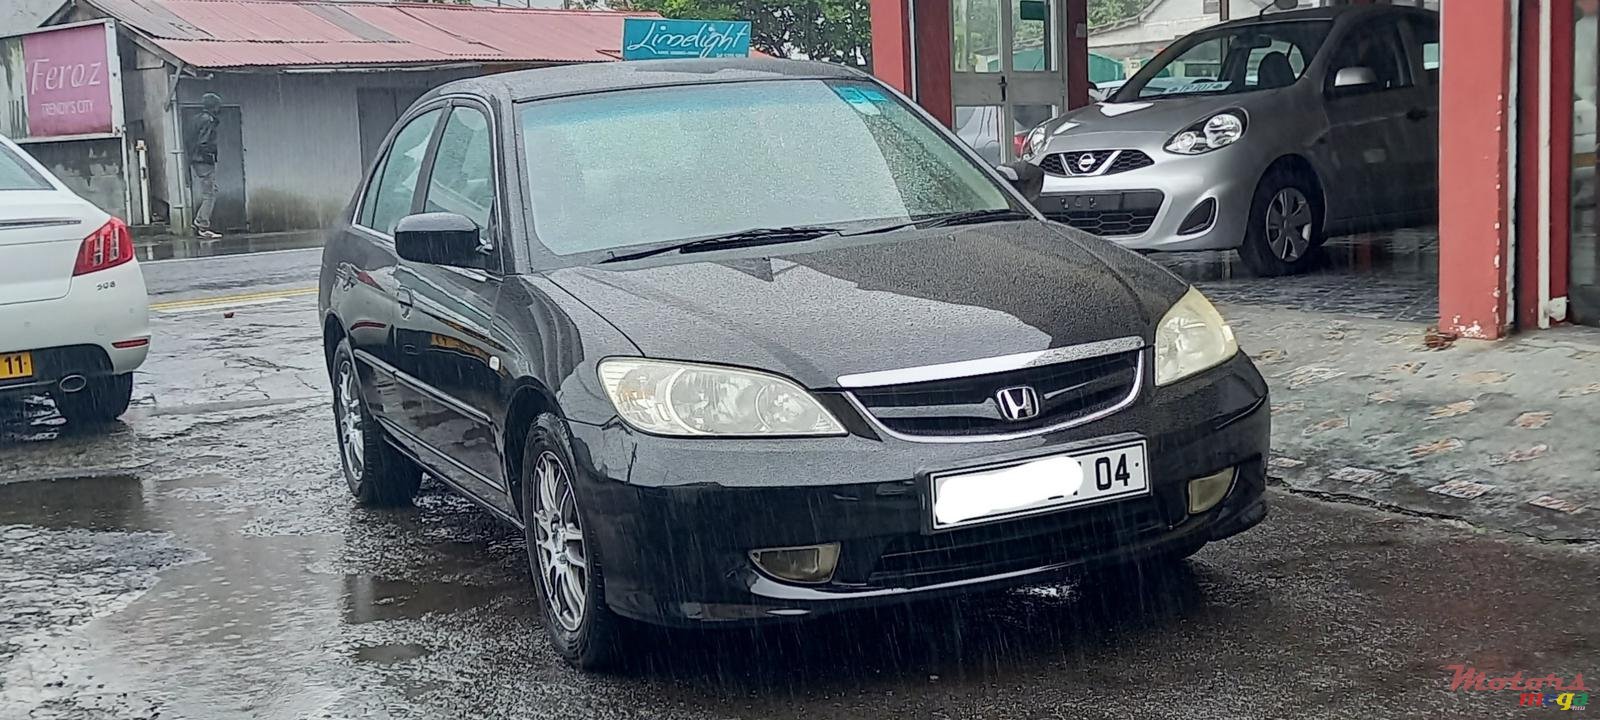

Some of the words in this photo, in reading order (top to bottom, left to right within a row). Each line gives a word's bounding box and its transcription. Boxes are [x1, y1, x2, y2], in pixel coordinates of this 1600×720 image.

[627, 21, 748, 58] Limelight
[31, 58, 101, 95] Feroz
[1095, 453, 1130, 491] 04
